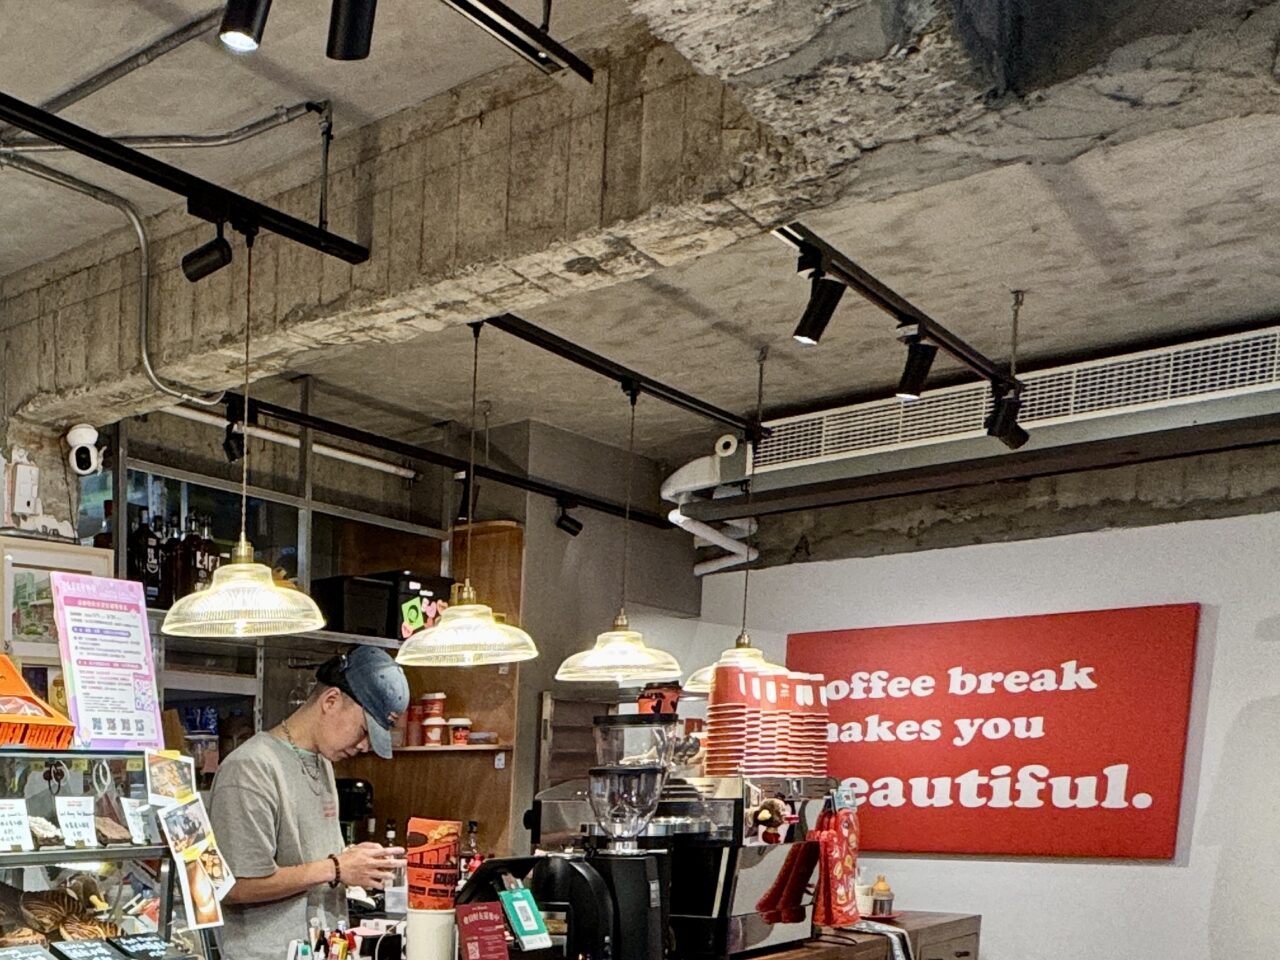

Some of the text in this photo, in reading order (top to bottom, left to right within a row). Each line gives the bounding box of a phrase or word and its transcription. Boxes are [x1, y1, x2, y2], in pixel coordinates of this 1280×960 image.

[825, 660, 1098, 701] offee break
[953, 715, 1045, 747] you
[840, 763, 1153, 809] eautiful.
